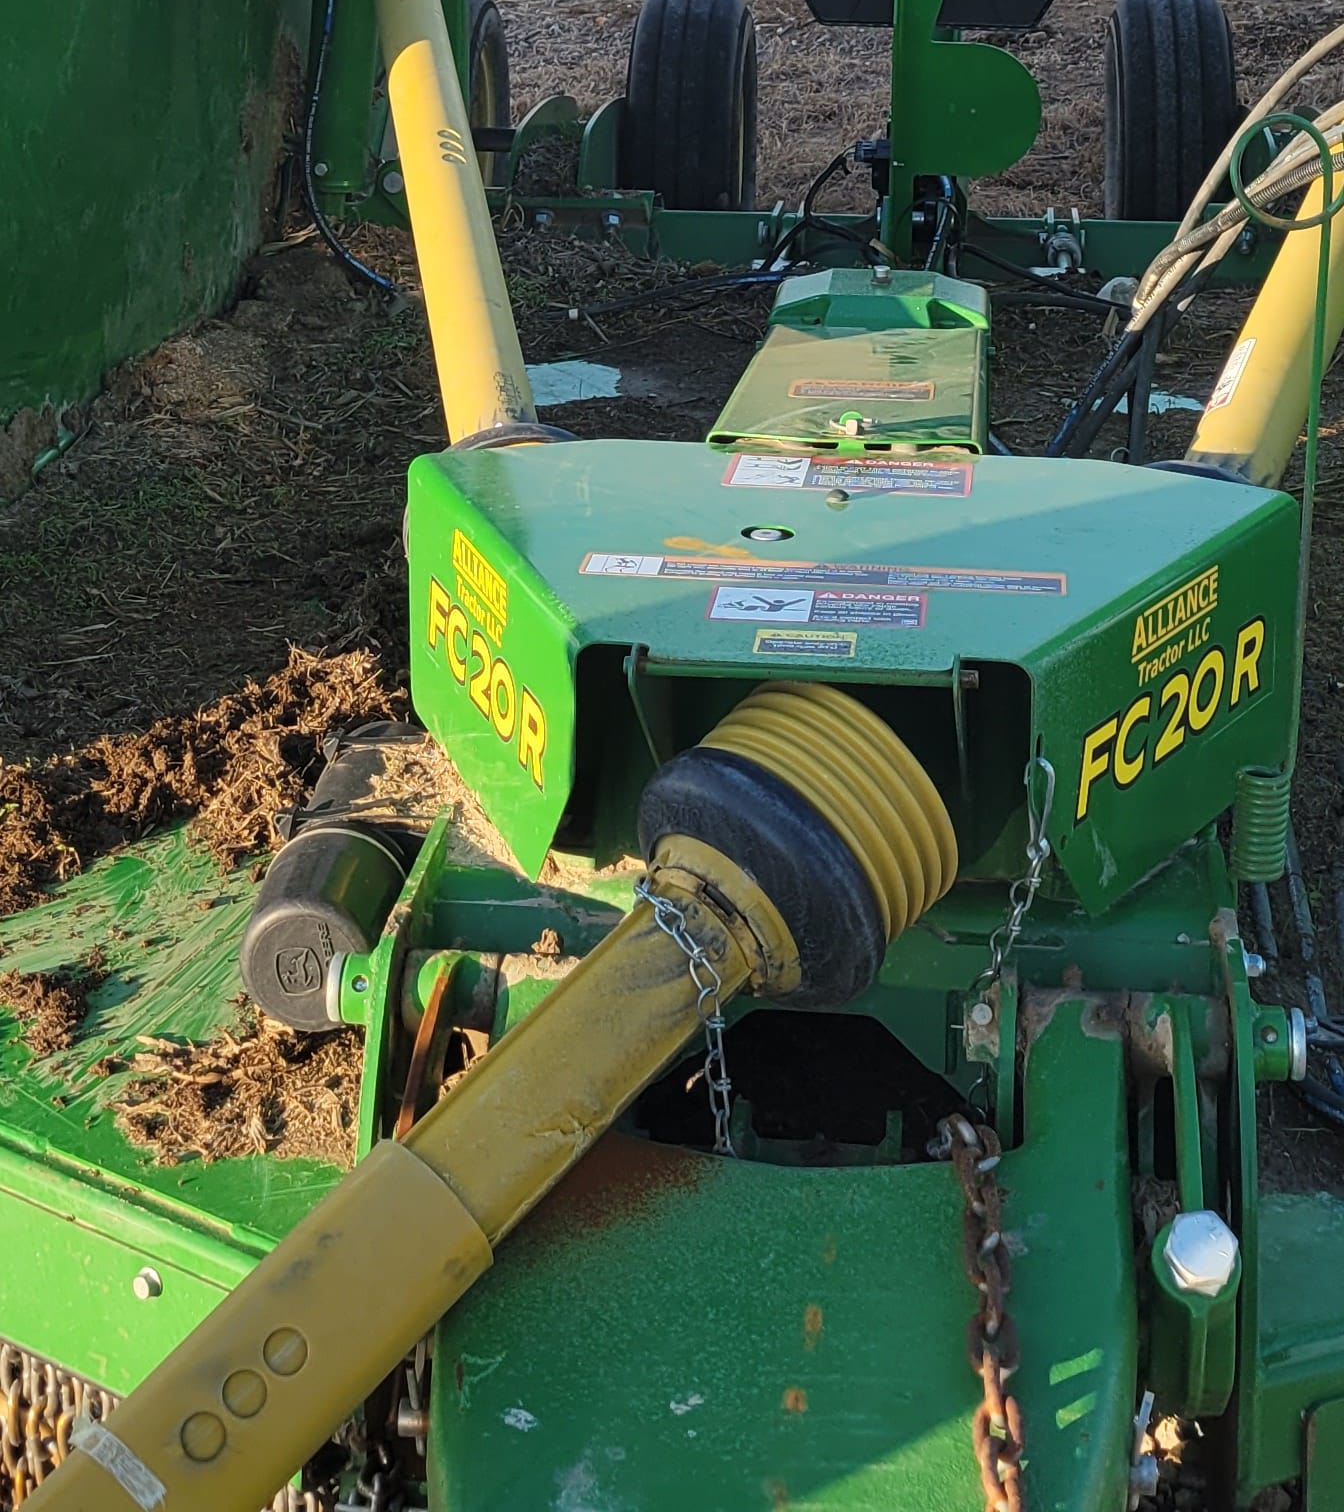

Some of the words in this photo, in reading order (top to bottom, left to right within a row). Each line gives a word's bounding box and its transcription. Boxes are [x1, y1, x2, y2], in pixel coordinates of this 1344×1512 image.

[867, 459, 934, 468] DANGER
[453, 529, 507, 626] ALLIANCE
[457, 575, 487, 628] Tractor
[486, 615, 504, 648] LLC
[842, 592, 921, 602] DANGER
[1132, 565, 1218, 663] ALLIANCE
[1137, 640, 1185, 687] Tractor
[1187, 617, 1210, 652] LLC
